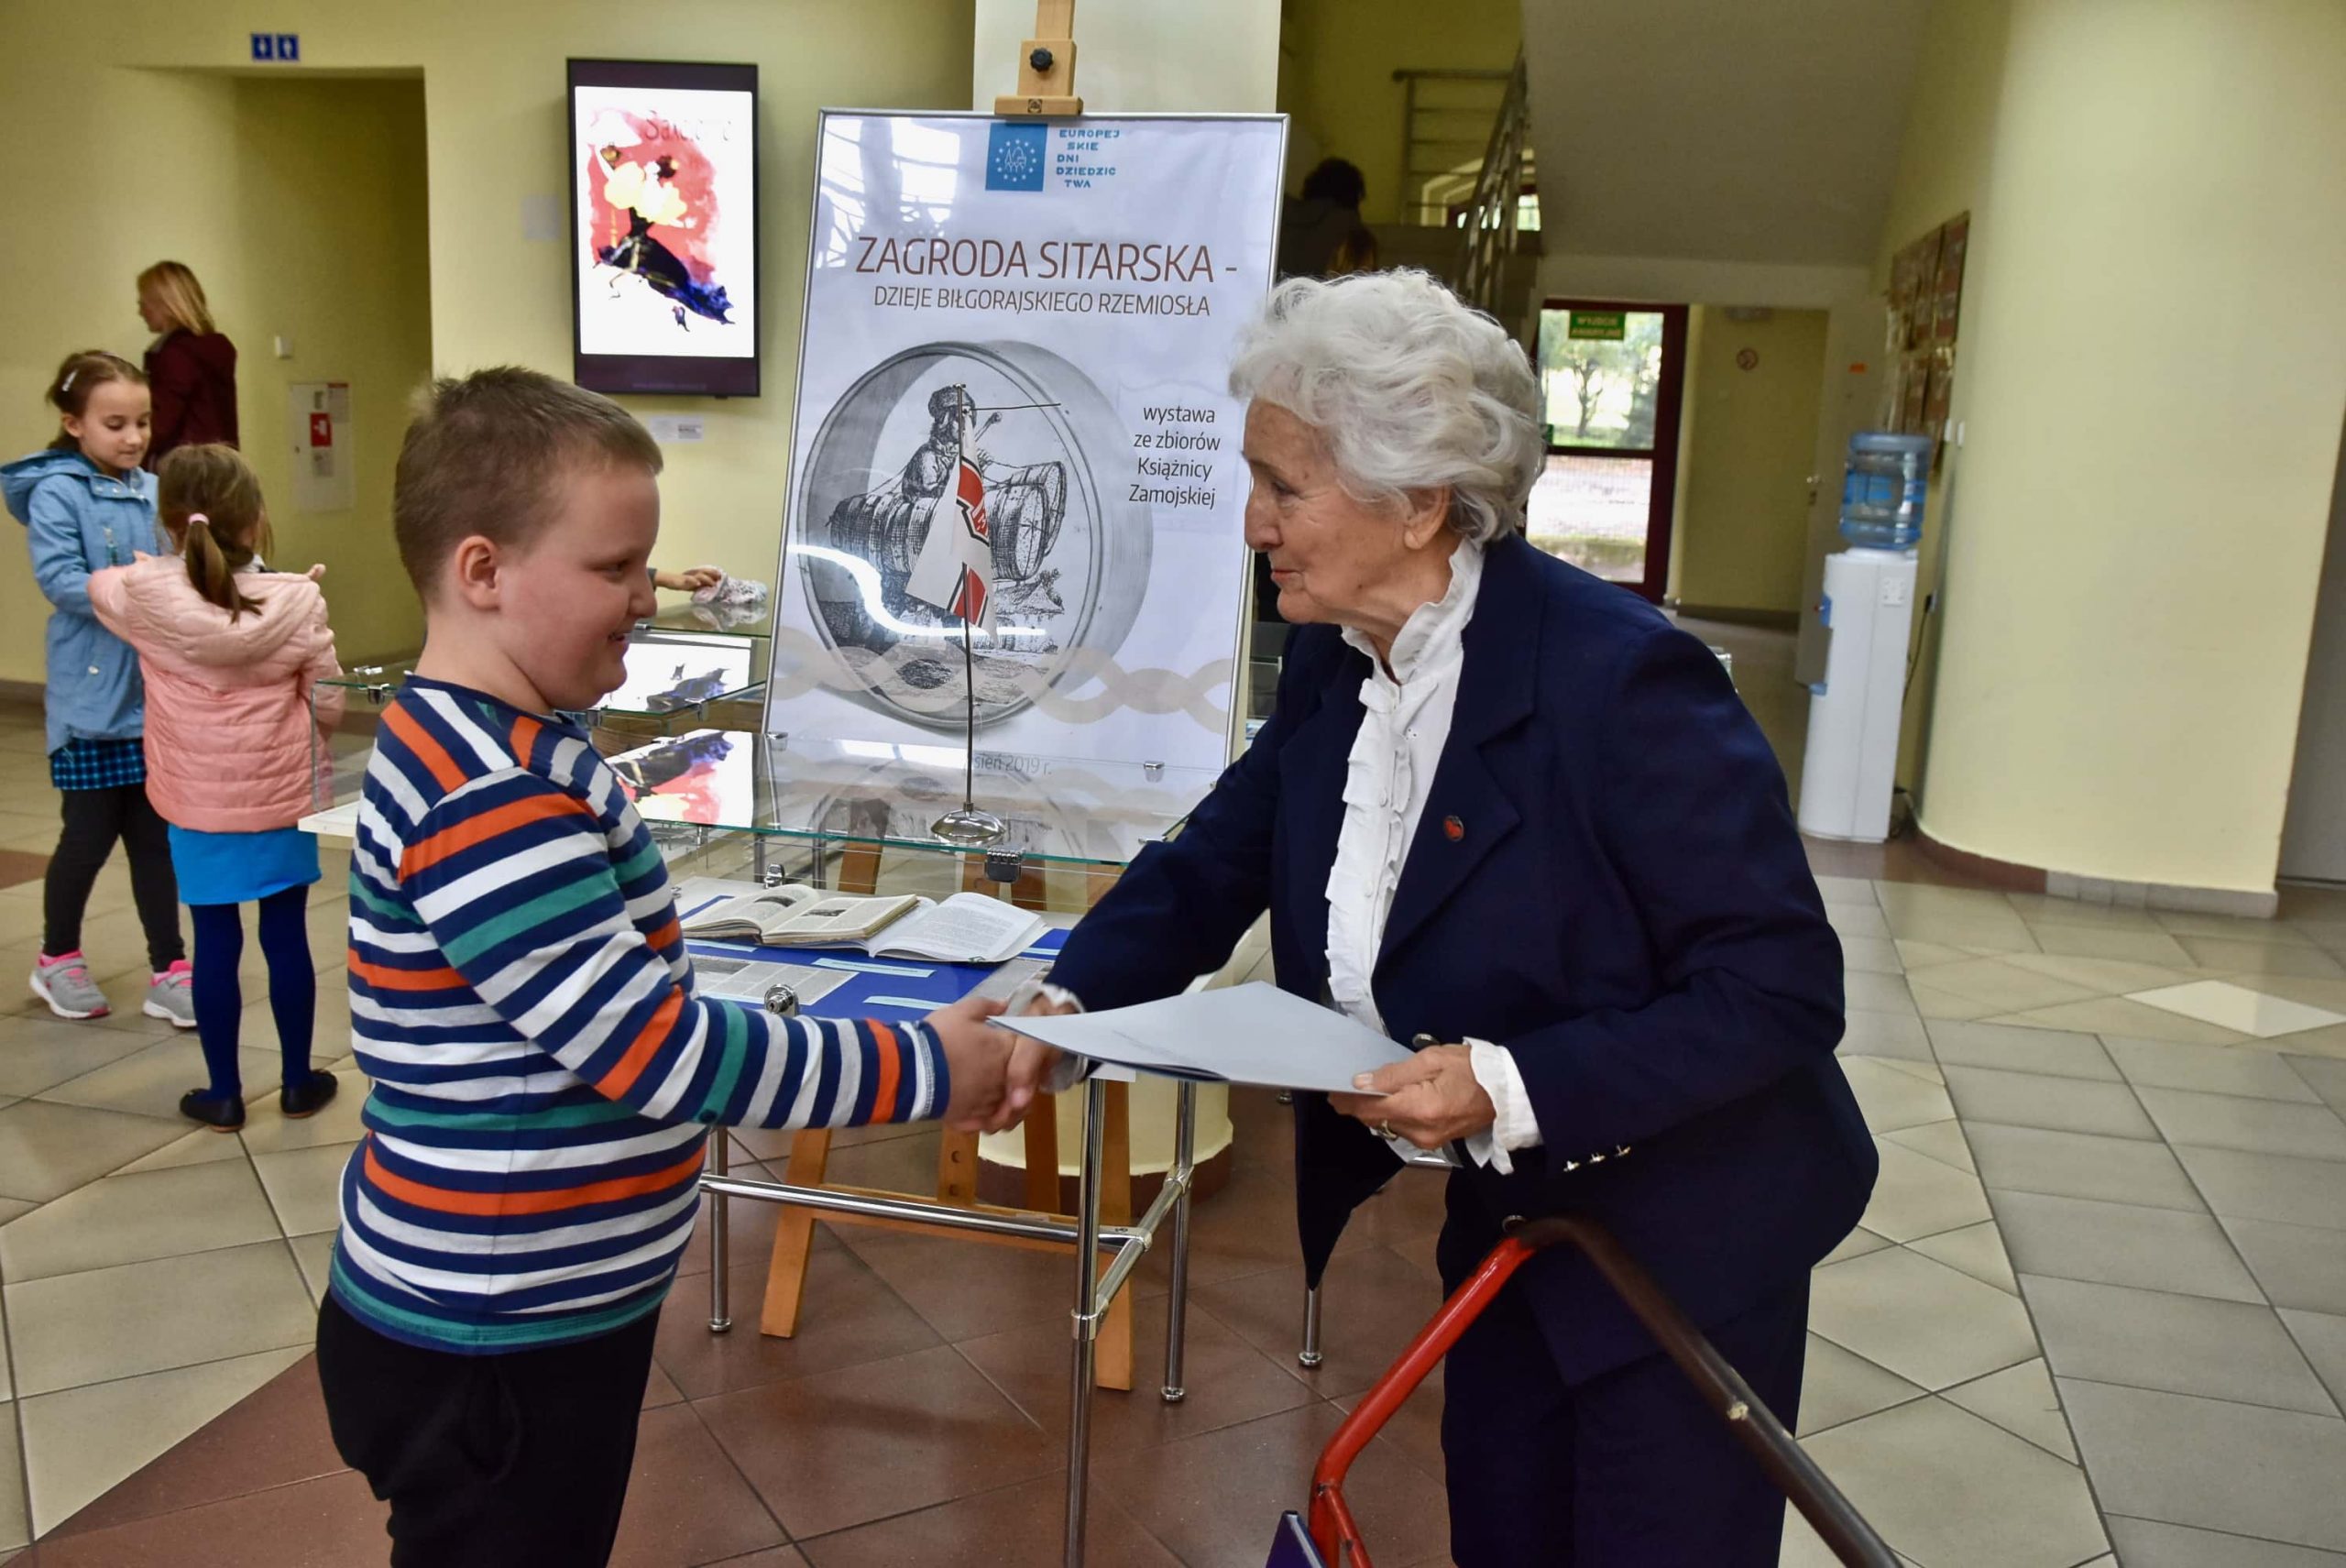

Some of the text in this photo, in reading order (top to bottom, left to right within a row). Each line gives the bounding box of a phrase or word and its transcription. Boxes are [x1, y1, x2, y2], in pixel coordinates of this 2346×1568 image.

[1059, 129, 1120, 138] EUROPEJ
[1067, 142, 1099, 150] SKIE
[1057, 154, 1079, 163] DNI
[1056, 167, 1116, 176] DZIEDZIC
[1064, 180, 1091, 188] TWA
[856, 236, 1028, 278] ZAGRODA
[1037, 241, 1214, 283] SITARSKA
[874, 286, 1211, 316] DZIEJE BIŁGORAJSKIEGO RZEMIOSŁA
[1143, 406, 1215, 425] wystawa
[1134, 430, 1221, 451] ze zbiorów
[1138, 457, 1212, 482] Książnicy
[1129, 484, 1215, 510] Zamojskiej
[1006, 754, 1040, 773] 2019
